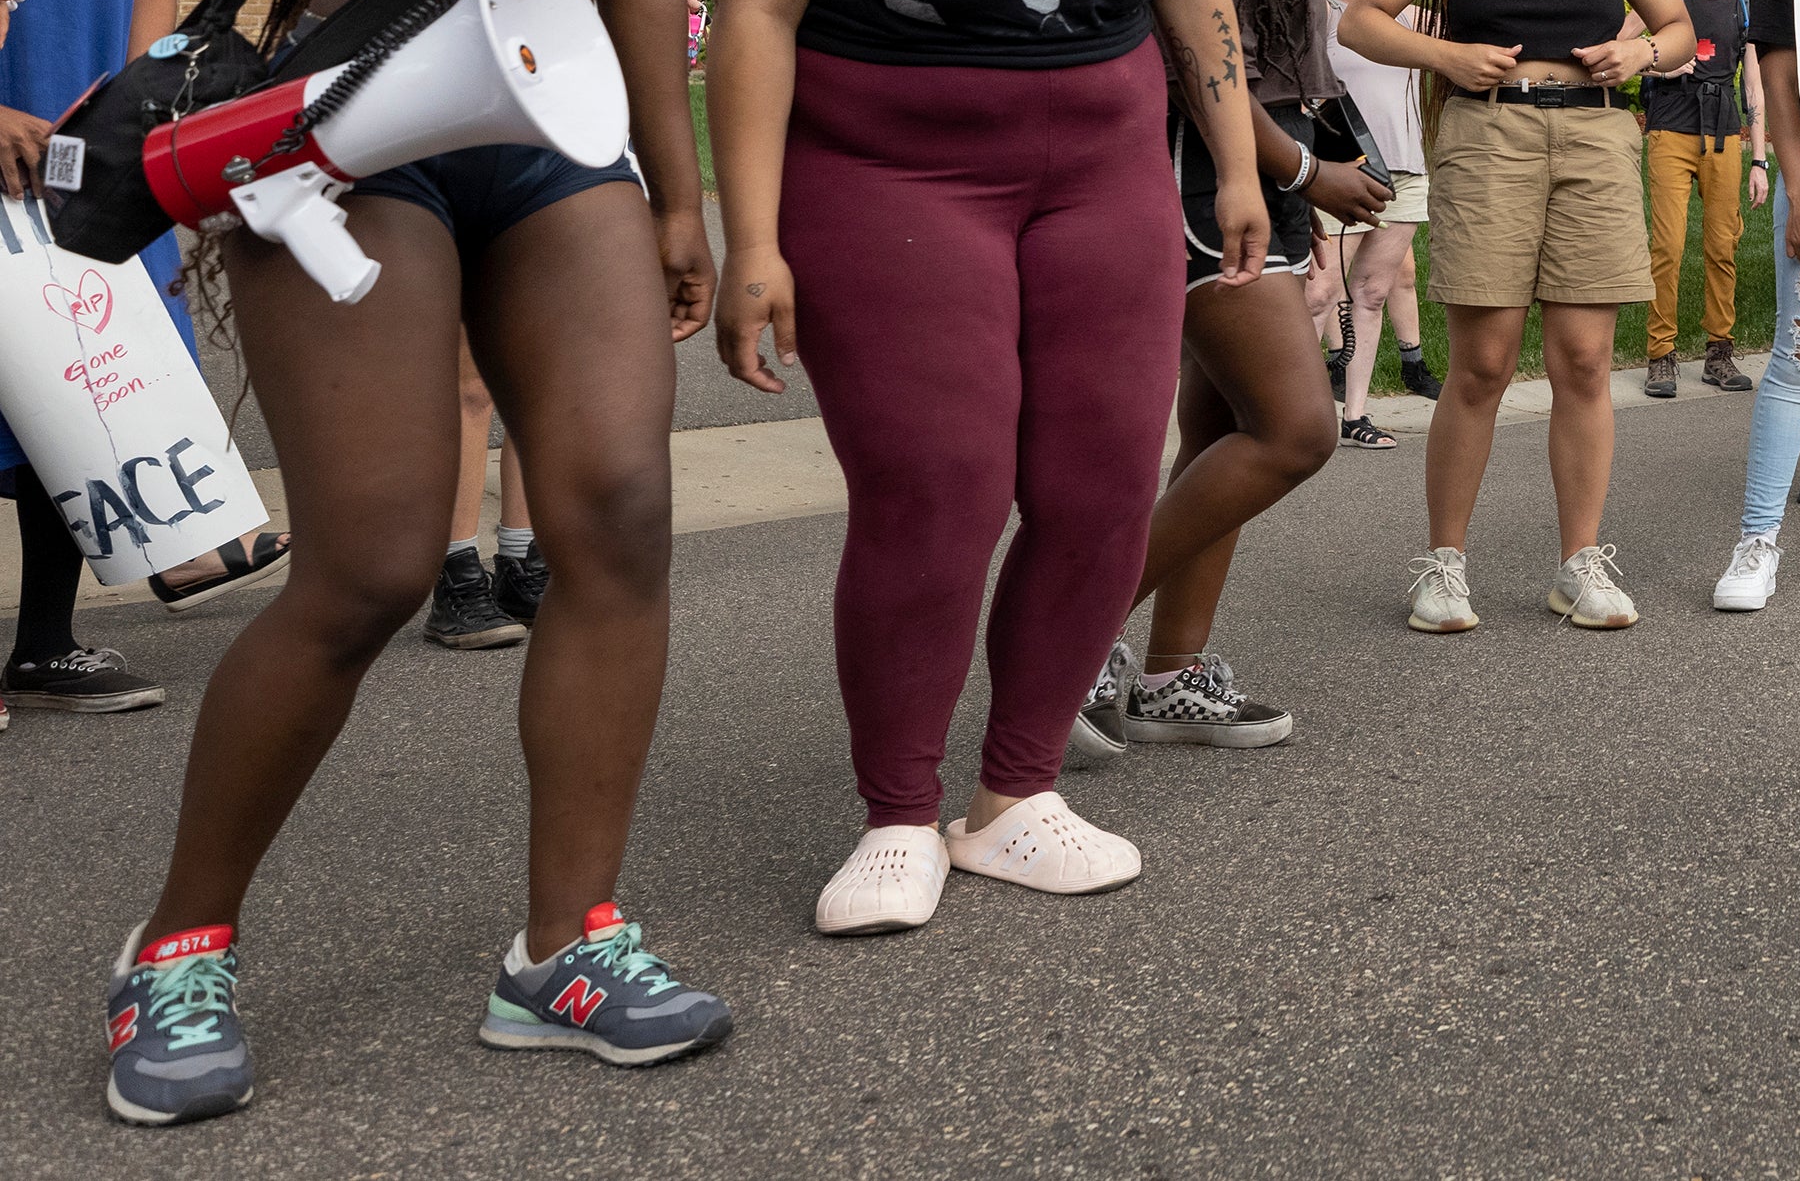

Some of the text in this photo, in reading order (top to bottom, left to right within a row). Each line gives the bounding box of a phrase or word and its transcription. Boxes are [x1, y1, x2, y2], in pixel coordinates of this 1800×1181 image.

[70, 292, 104, 317] RIP
[64, 342, 129, 383] Gone
[82, 371, 119, 393] too
[181, 934, 211, 952] 574
[549, 974, 609, 1028] N
